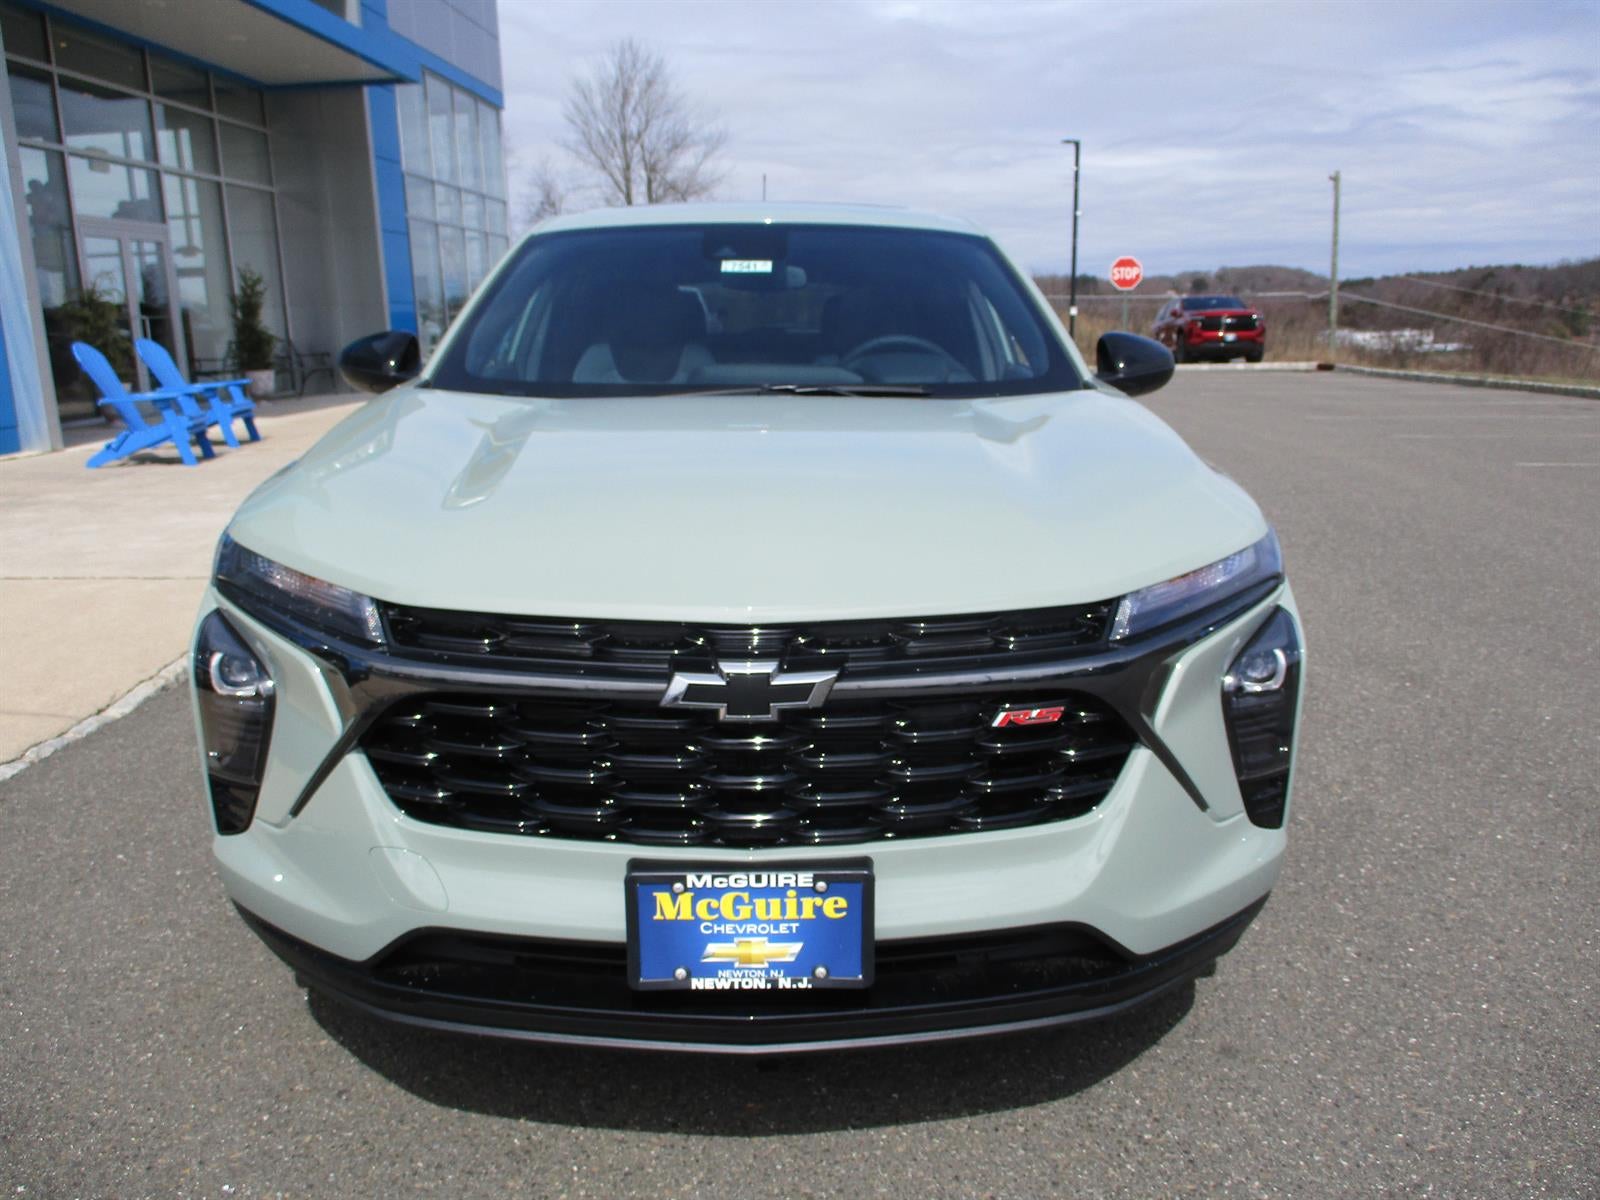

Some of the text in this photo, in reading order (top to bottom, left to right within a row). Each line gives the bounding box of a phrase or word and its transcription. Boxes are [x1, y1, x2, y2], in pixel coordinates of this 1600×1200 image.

[1112, 267, 1140, 280] STOP
[992, 706, 1064, 727] RS
[686, 873, 814, 888] McGUIRE
[653, 890, 848, 920] McGuire
[700, 922, 799, 935] CHEVROLET
[770, 969, 784, 978] NJ
[778, 977, 812, 989] N.J.
